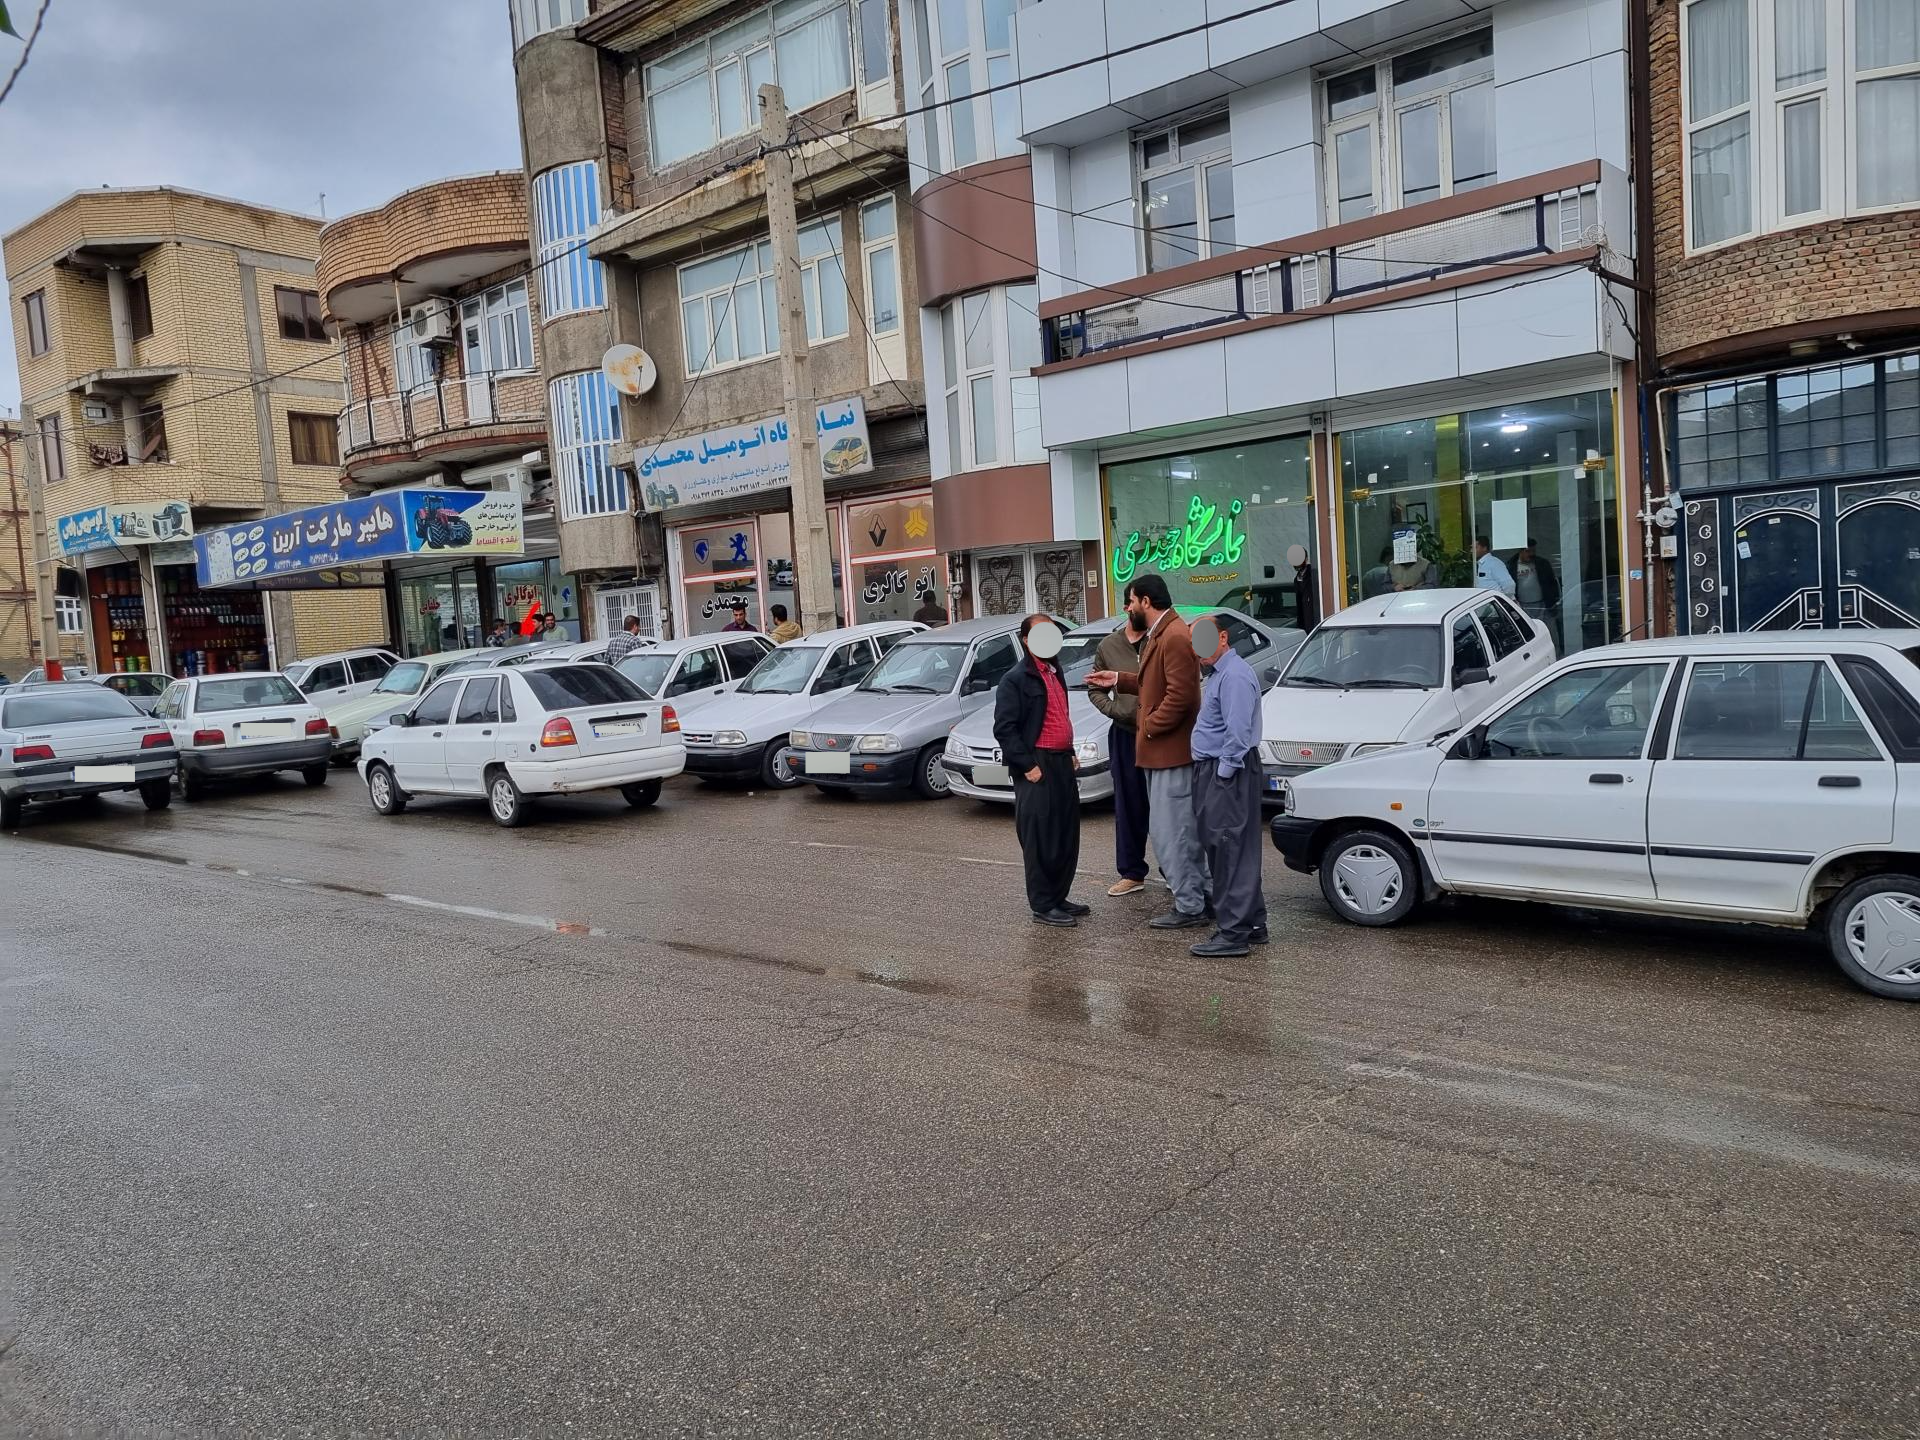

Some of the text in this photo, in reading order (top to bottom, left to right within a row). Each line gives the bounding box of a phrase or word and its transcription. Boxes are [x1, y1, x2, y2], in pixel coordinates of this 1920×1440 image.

[640, 404, 855, 477] نمایگاه اتومبیل محمدی
[483, 501, 498, 509] فروش
[272, 520, 303, 553] آرین
[357, 506, 394, 543] هایپر
[862, 567, 937, 604] اتو گالری
[701, 592, 749, 619] محمدی
